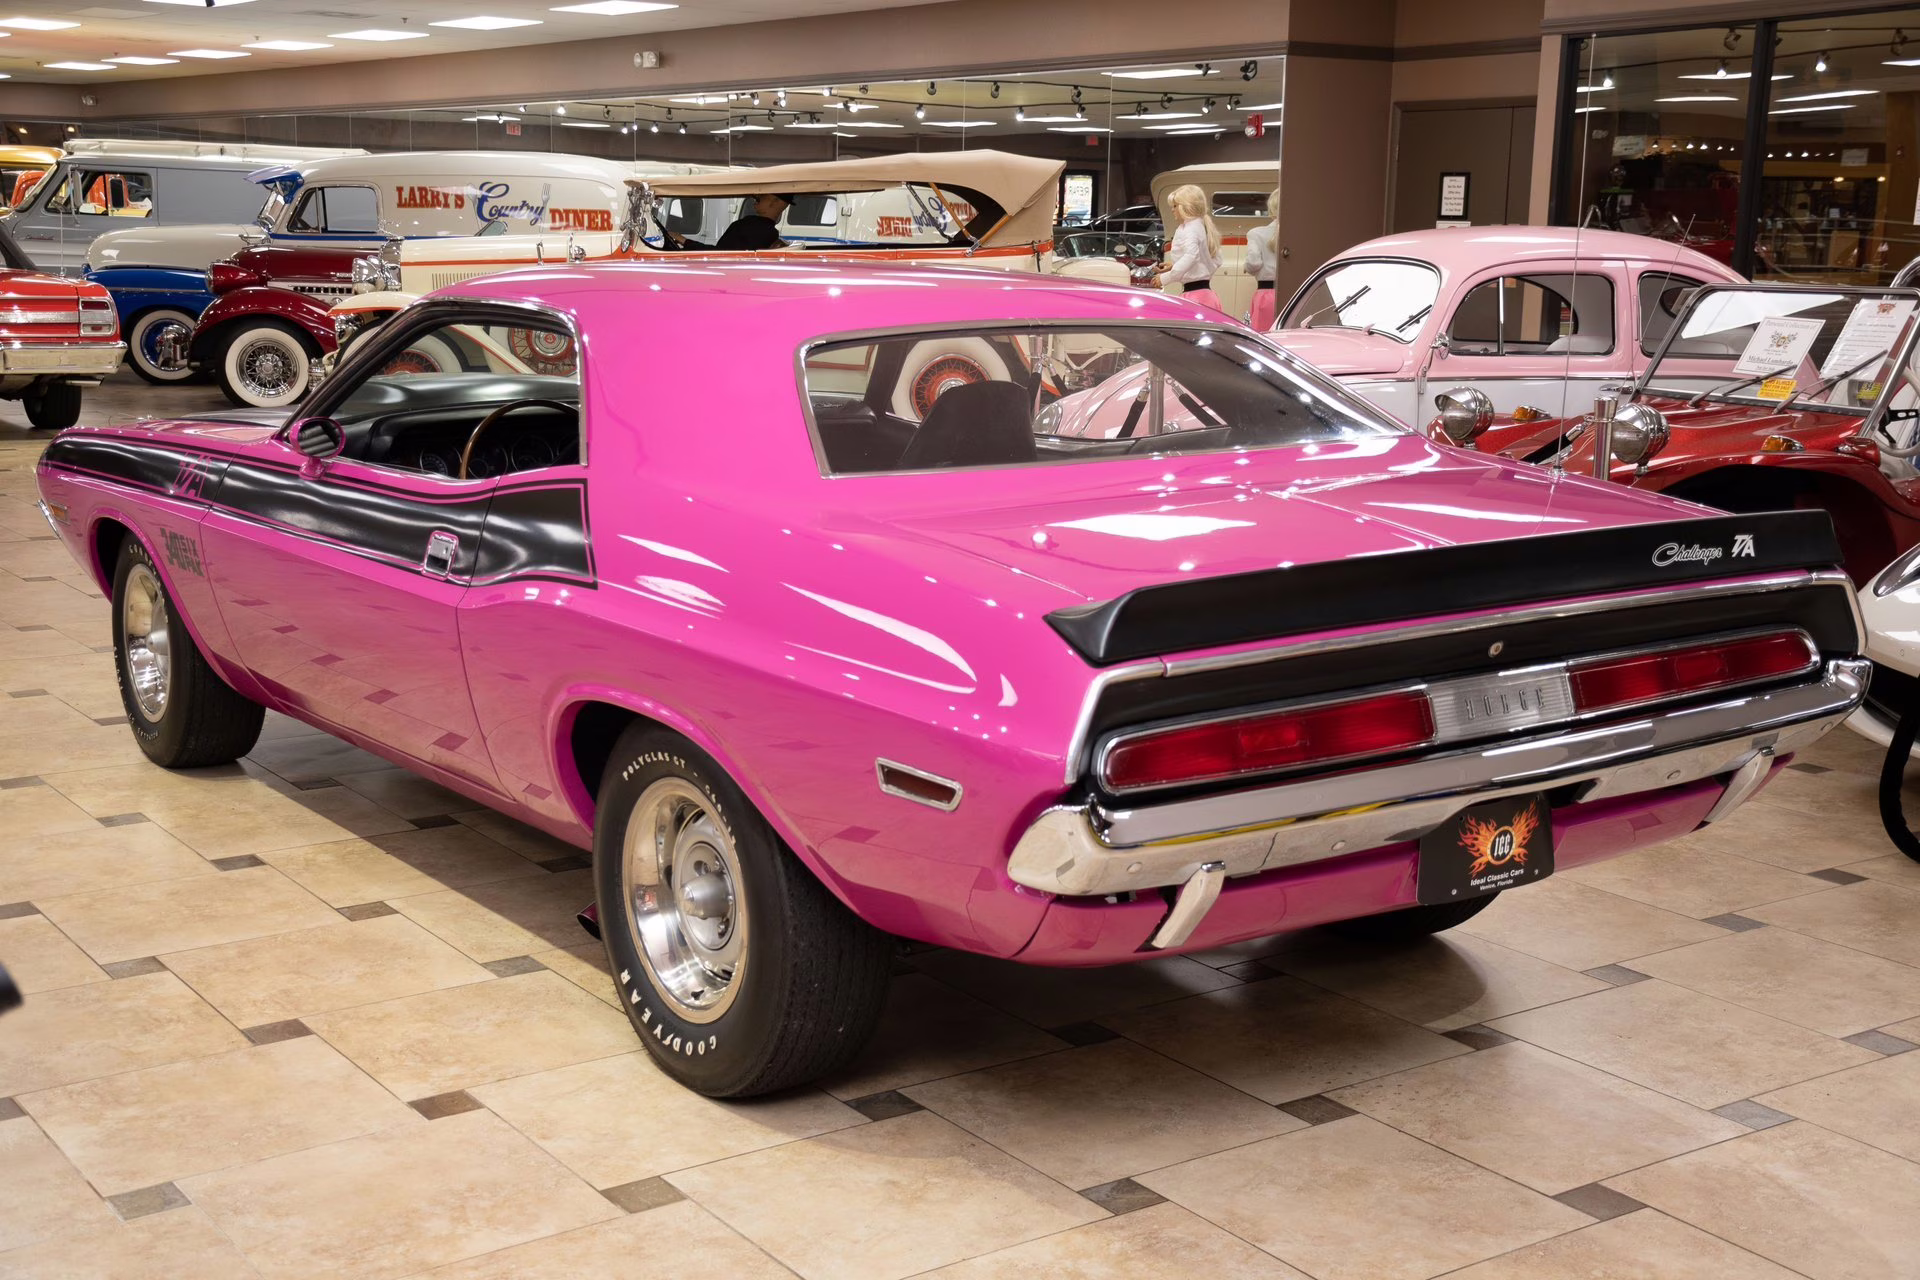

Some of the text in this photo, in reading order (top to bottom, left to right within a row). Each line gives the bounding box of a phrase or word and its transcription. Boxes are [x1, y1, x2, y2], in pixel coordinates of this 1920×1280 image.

[396, 181, 613, 231] LARRY'S Country DINER
[179, 534, 199, 558] SIX
[1652, 542, 1722, 567] Challenger
[1464, 688, 1545, 720] DODGE
[622, 751, 671, 781] POLYGLAS
[673, 756, 687, 770] GT
[1471, 868, 1524, 886] Ideal Classic Cars
[620, 967, 717, 1057] GOODYEAR
